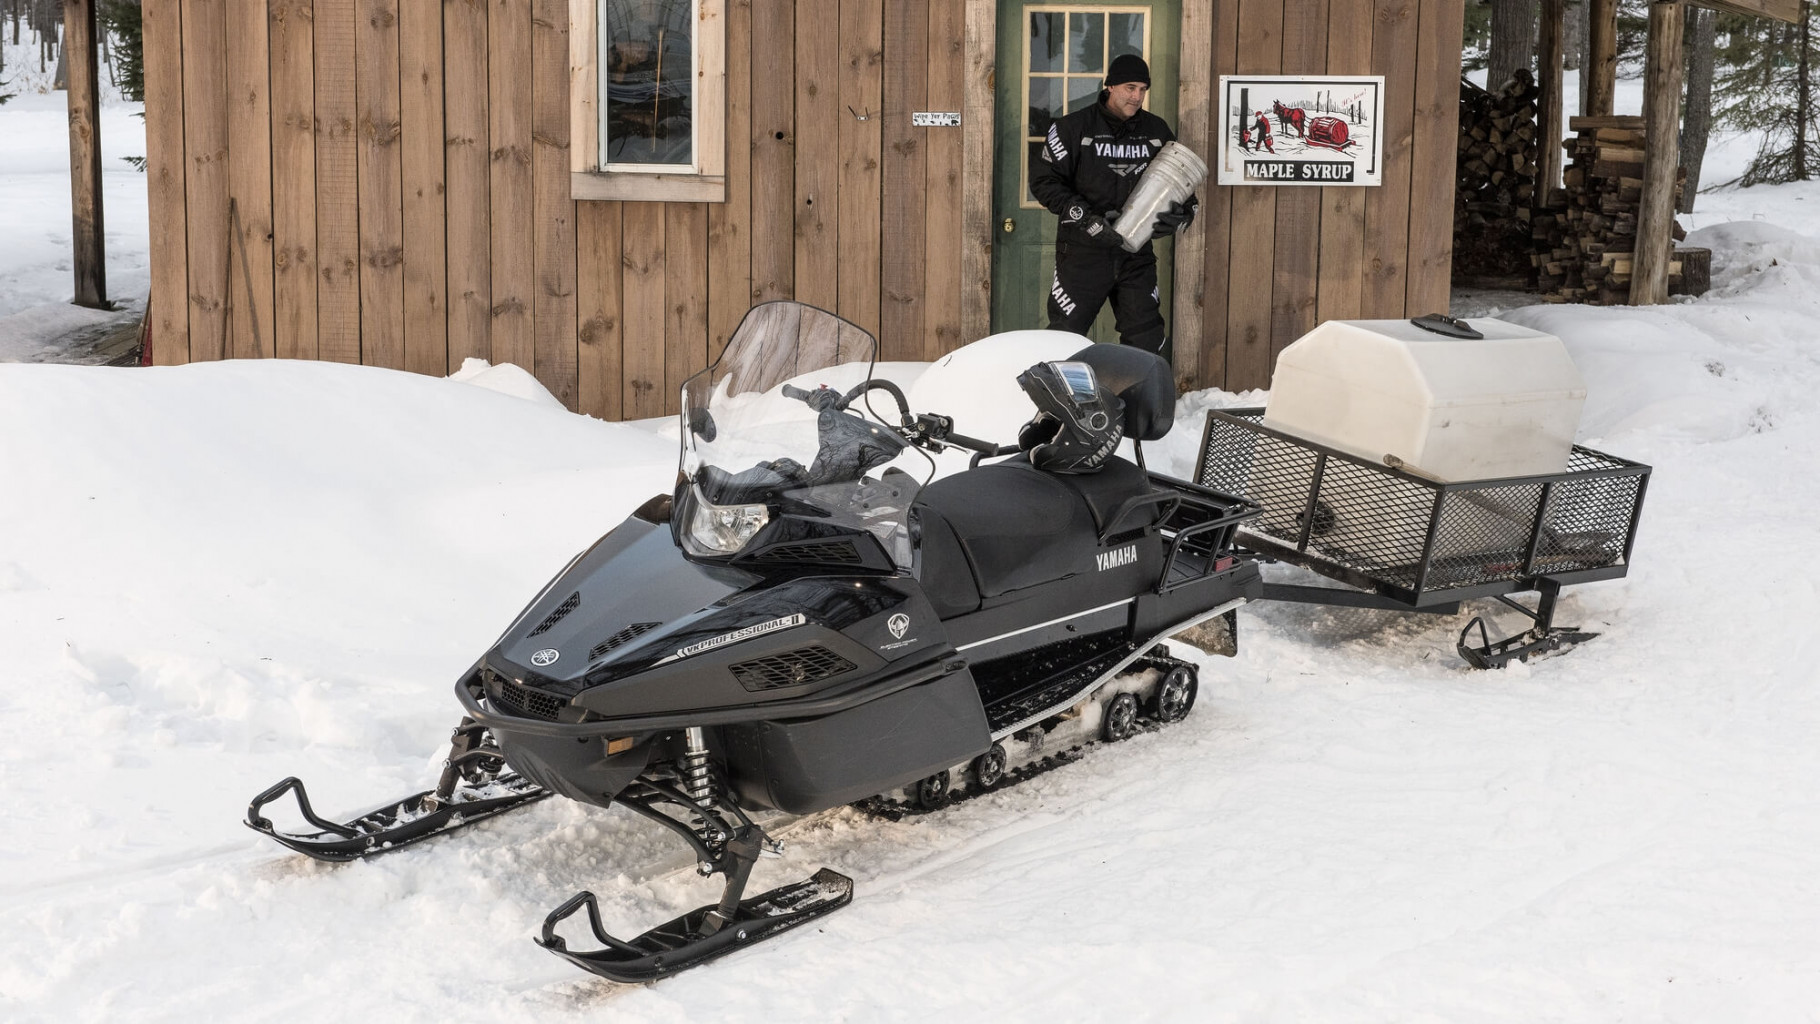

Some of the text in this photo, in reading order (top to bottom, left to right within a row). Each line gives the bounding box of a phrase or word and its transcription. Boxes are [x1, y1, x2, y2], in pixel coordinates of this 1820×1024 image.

[1095, 143, 1150, 158] YAMAHA
[1246, 163, 1352, 179] MAPLE SYRUP
[1083, 424, 1122, 467] YAMAHA
[1096, 544, 1138, 572] YAMAHA
